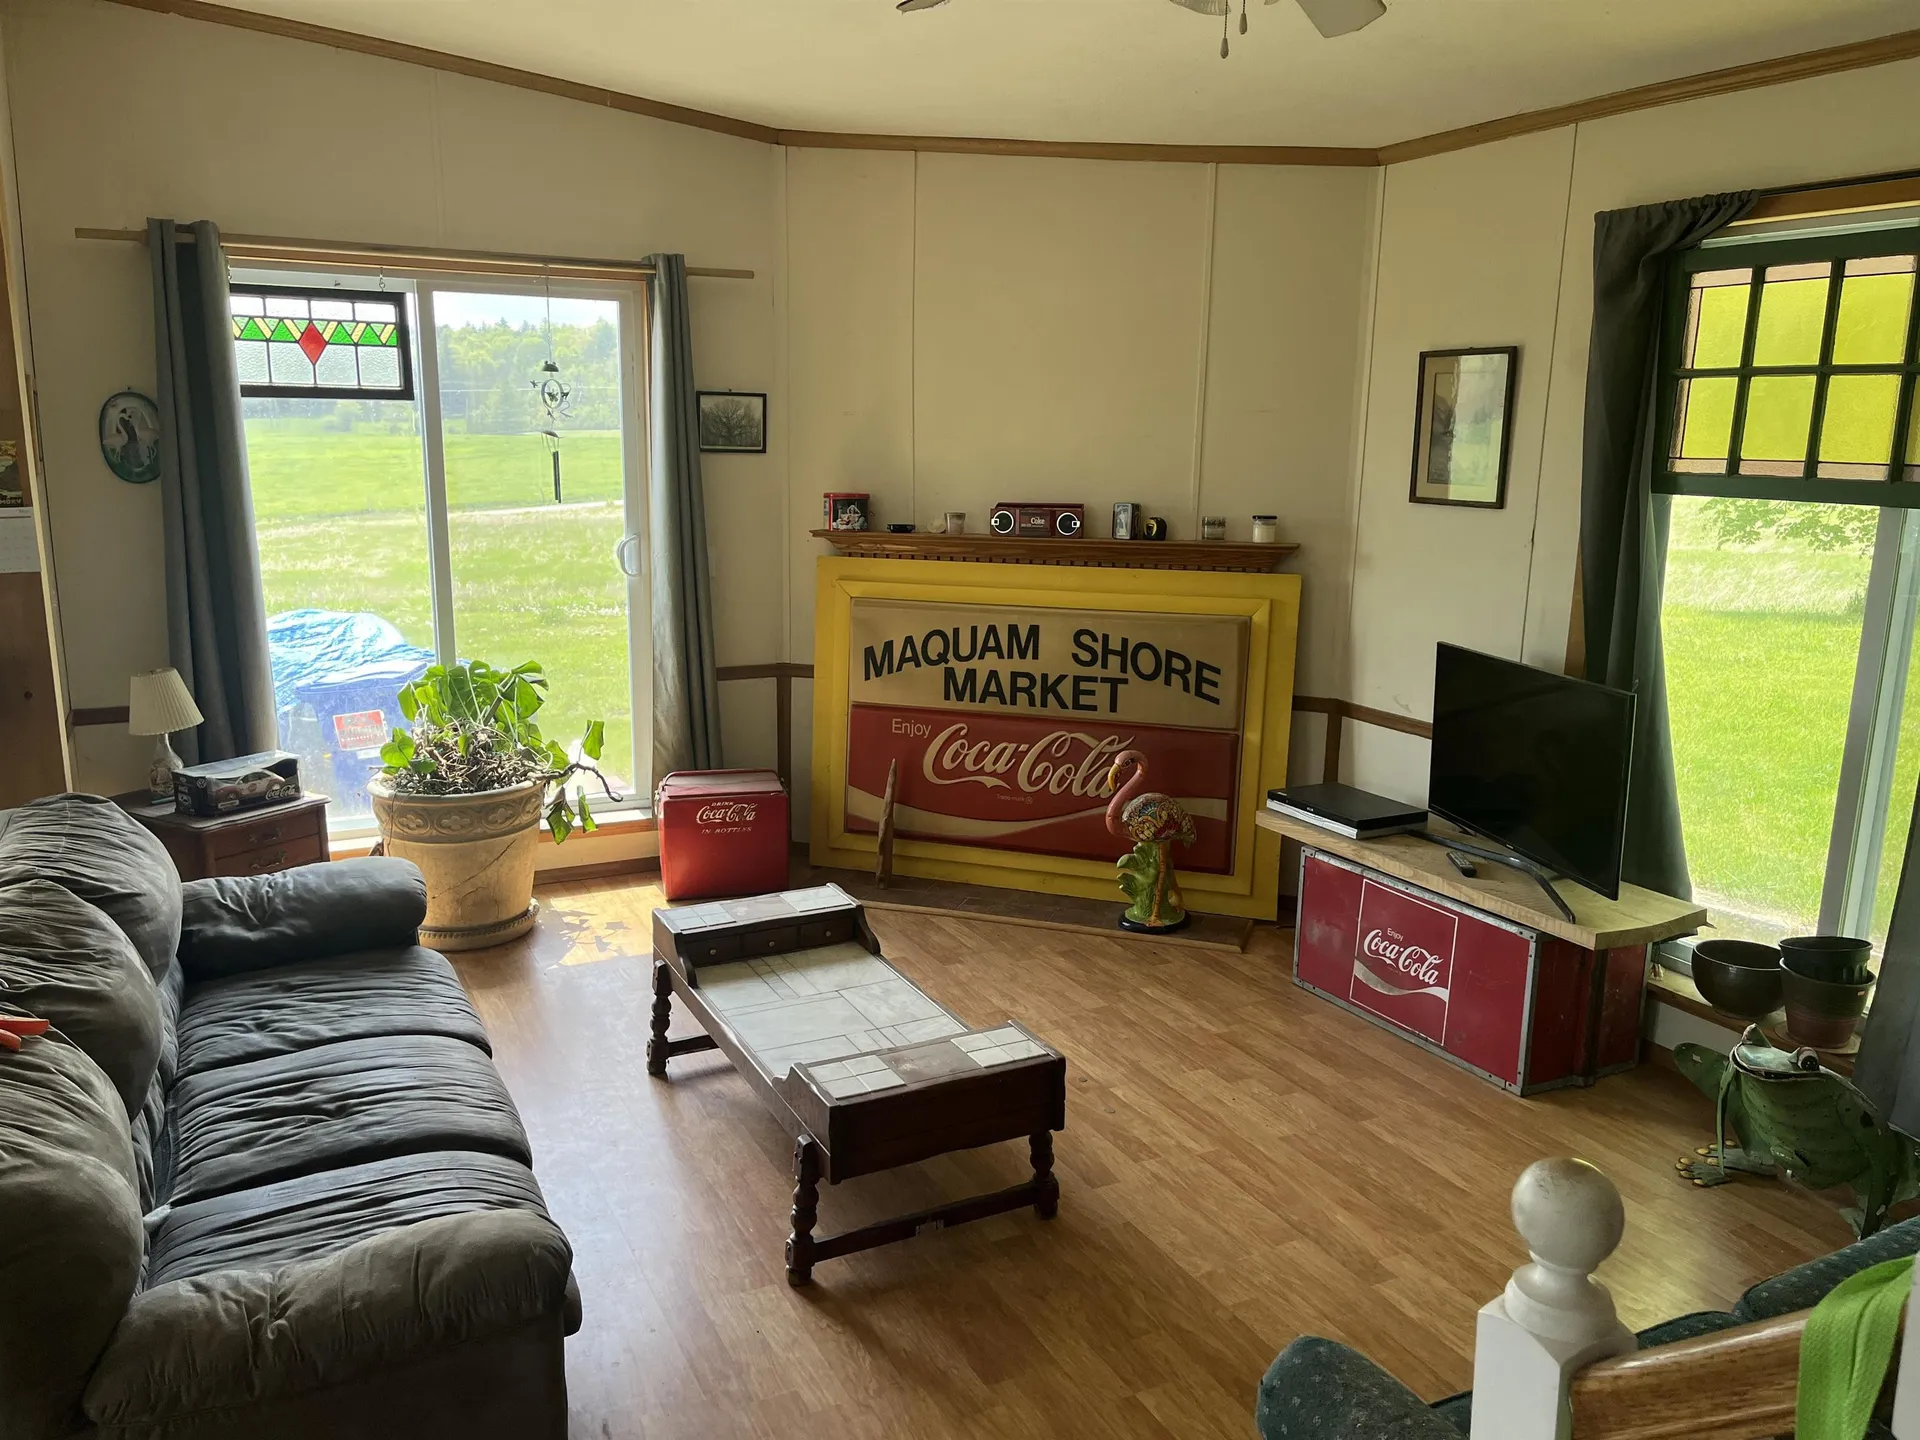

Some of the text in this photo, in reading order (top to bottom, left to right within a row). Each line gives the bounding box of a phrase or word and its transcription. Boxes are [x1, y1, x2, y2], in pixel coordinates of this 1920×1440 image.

[863, 624, 1221, 705] MAQUAM SHORE
[943, 666, 1129, 713] MARKET
[891, 718, 932, 739] Enjoy
[1363, 929, 1444, 985] Coca-Cola
[1387, 927, 1404, 942] Enjoy
